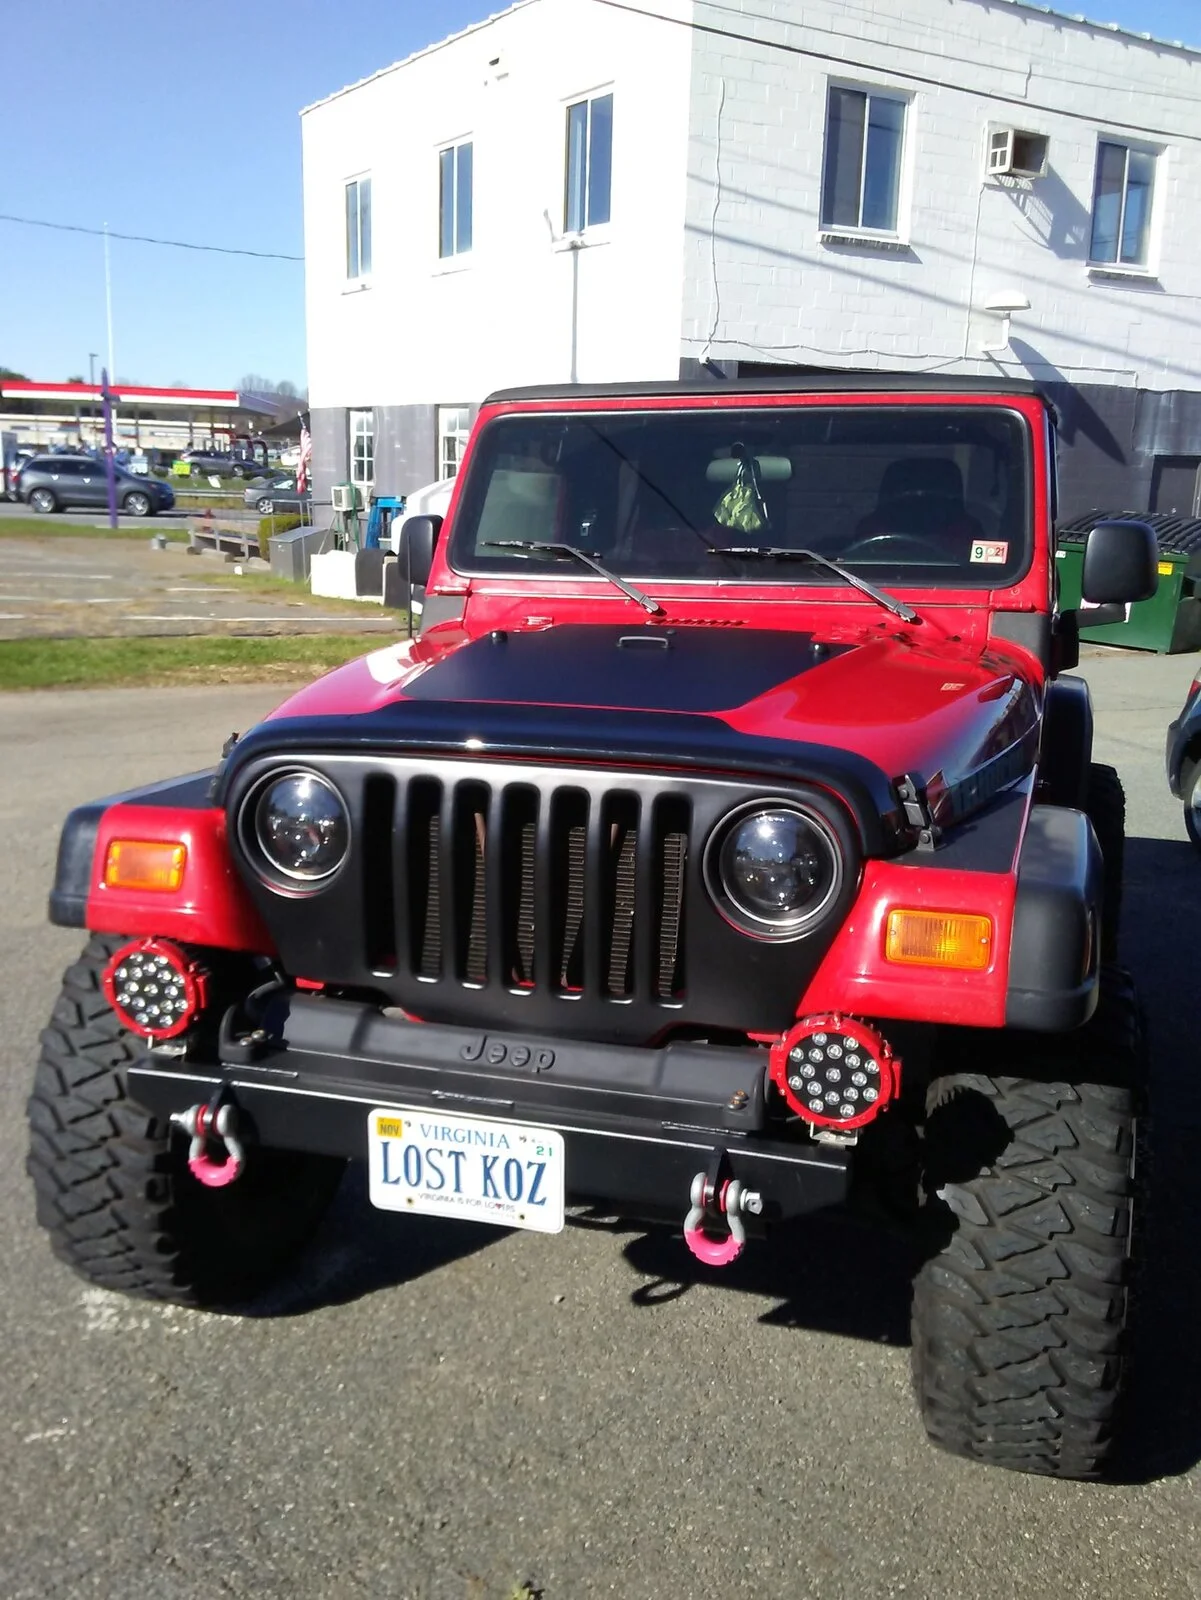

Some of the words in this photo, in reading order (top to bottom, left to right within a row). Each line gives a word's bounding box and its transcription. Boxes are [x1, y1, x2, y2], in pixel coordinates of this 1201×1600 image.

[975, 546, 983, 558] 9
[995, 547, 1004, 557] 21
[460, 1034, 556, 1073] Jeep
[380, 1124, 399, 1136] NOV
[420, 1123, 510, 1149] VIRGINIA
[536, 1145, 553, 1157] 21
[380, 1141, 467, 1194] LOST
[480, 1154, 548, 1207] KOZ
